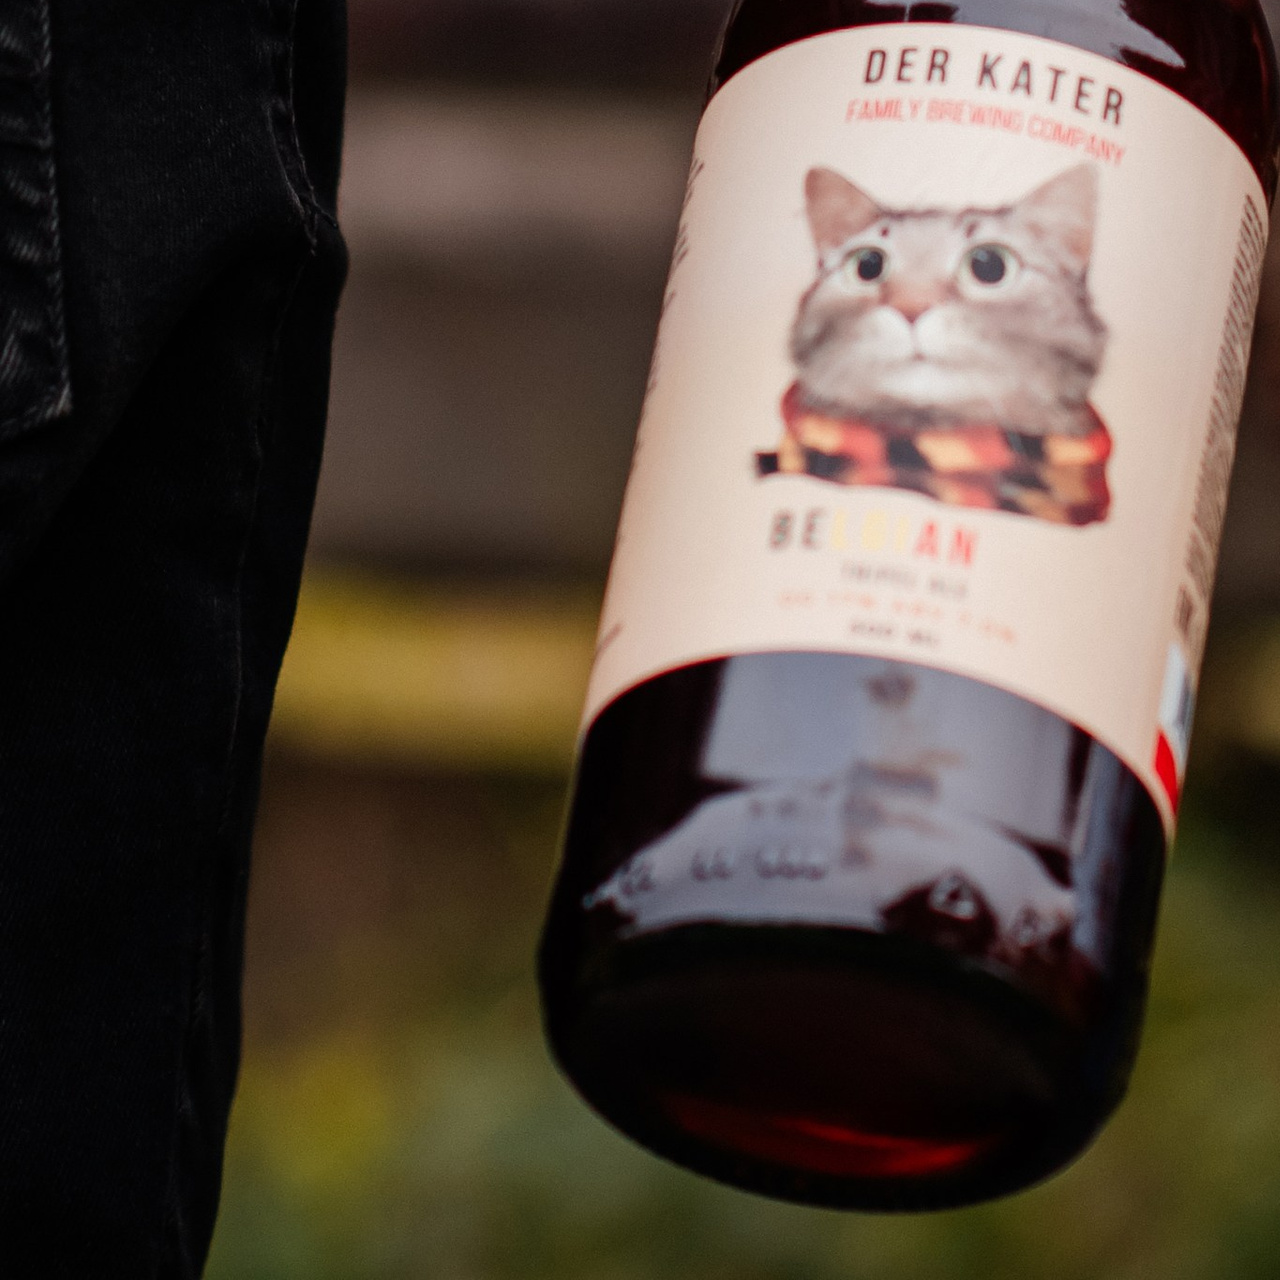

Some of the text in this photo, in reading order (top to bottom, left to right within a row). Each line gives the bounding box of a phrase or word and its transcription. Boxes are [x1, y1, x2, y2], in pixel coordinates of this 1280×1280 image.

[863, 47, 1124, 125] DER KATER
[845, 98, 1126, 166] FAMILY BREWING COMPANY
